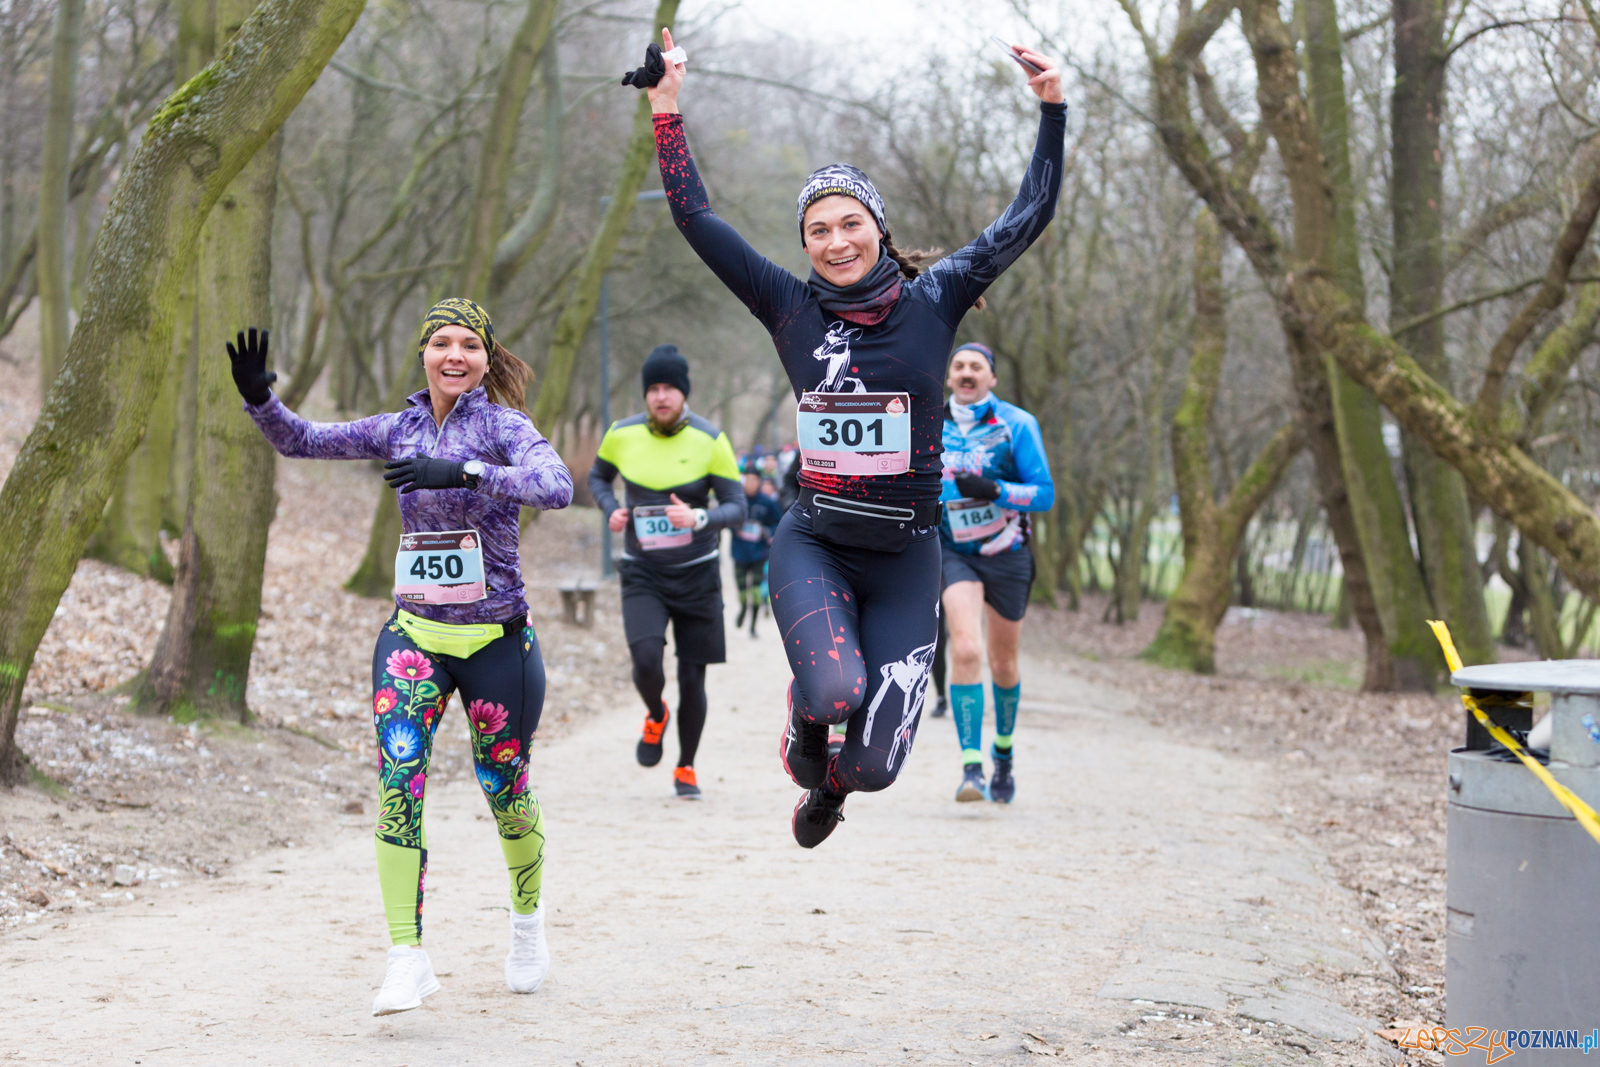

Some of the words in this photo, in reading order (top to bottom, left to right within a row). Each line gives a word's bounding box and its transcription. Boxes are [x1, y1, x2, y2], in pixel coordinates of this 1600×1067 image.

[818, 418, 884, 447] 301
[646, 519, 681, 534] 30
[960, 508, 994, 526] 184
[410, 555, 463, 579] 450
